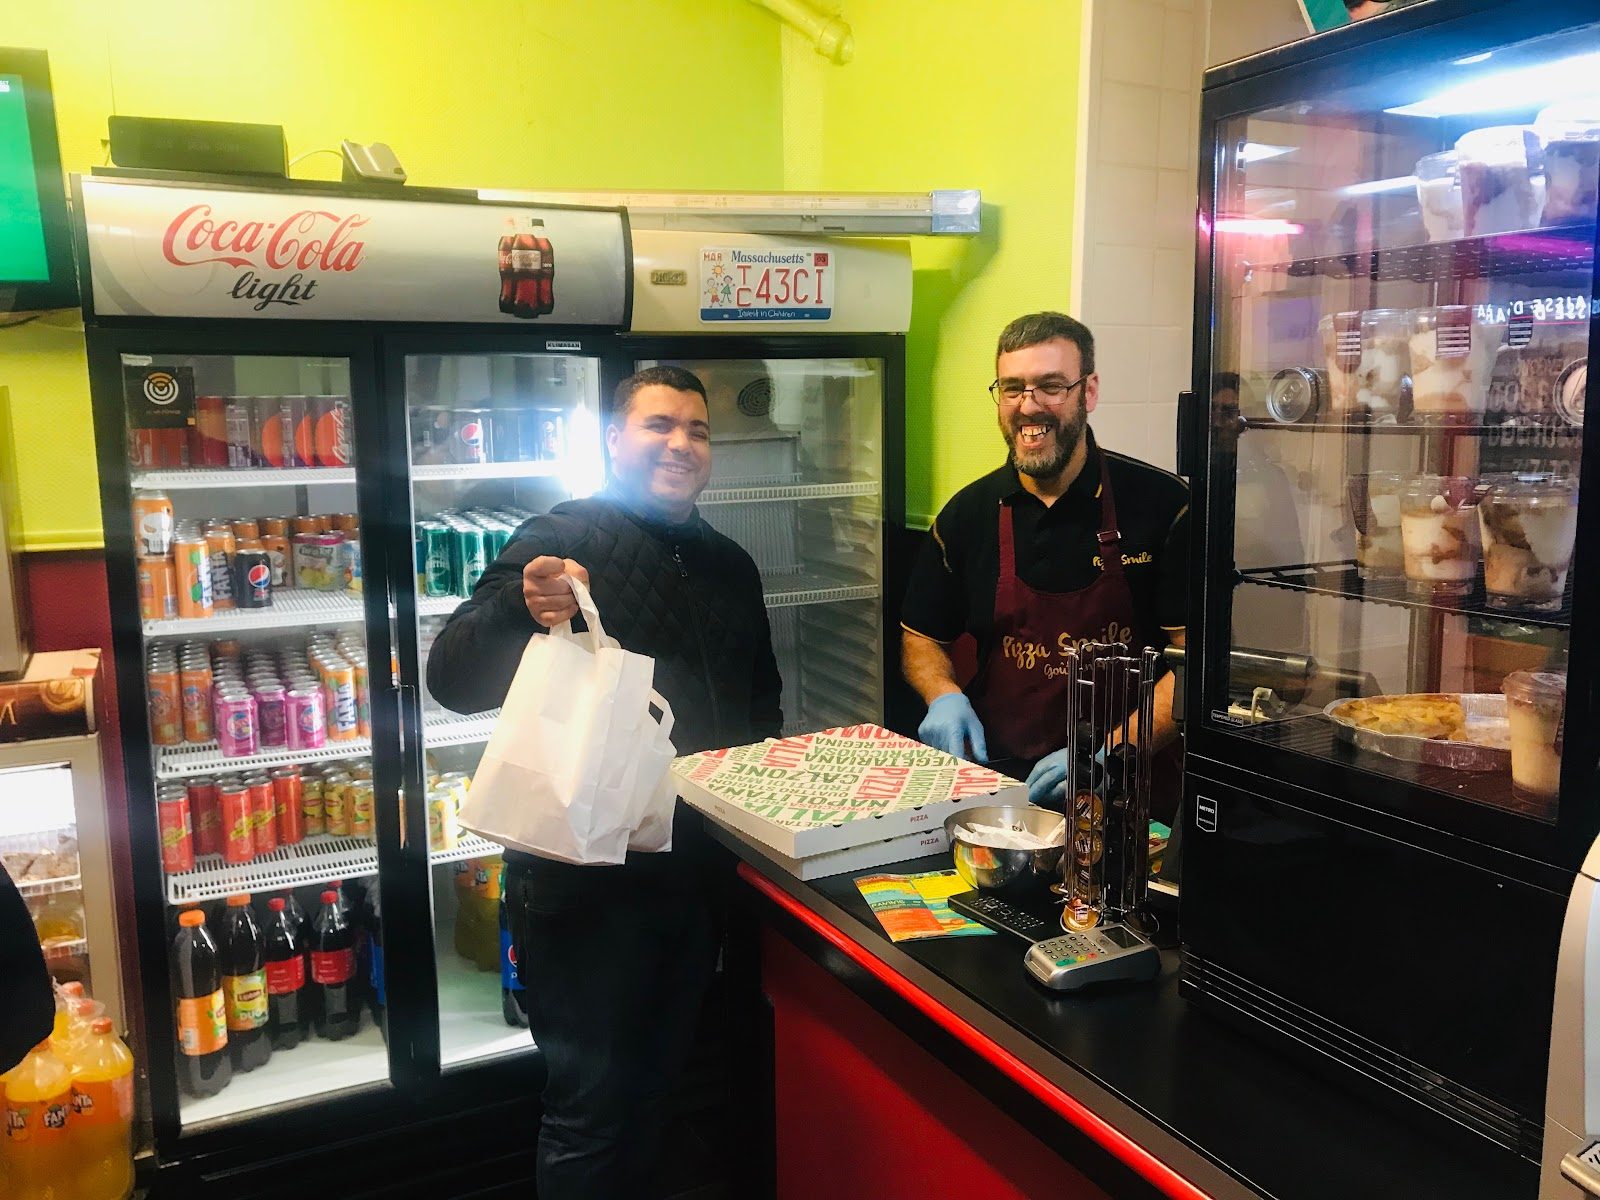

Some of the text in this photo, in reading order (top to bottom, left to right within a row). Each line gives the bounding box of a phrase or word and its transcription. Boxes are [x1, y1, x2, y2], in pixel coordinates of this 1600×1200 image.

[162, 204, 372, 272] Coca-Cola
[703, 252, 723, 262] MAR
[731, 250, 805, 265] Massachusetts
[226, 271, 319, 312] light
[1121, 552, 1152, 565] Smile
[1002, 622, 1133, 670] Pizza Smile
[816, 737, 876, 749] REGINA
[760, 735, 813, 768] TALIA
[813, 746, 940, 759] CAPRICCIOSA
[804, 752, 959, 768] VEGETARIANA
[728, 762, 860, 785] CALZONE
[808, 764, 865, 774] ITALIA
[714, 772, 765, 785] MARE
[853, 767, 910, 800] PIZZA
[706, 778, 849, 799] QUATTRO STAGIONI
[790, 782, 851, 793] FRUTTI
[708, 783, 890, 808] NAPOLITANA
[910, 813, 929, 823] PIZZA
[920, 837, 940, 847] PIZZA
